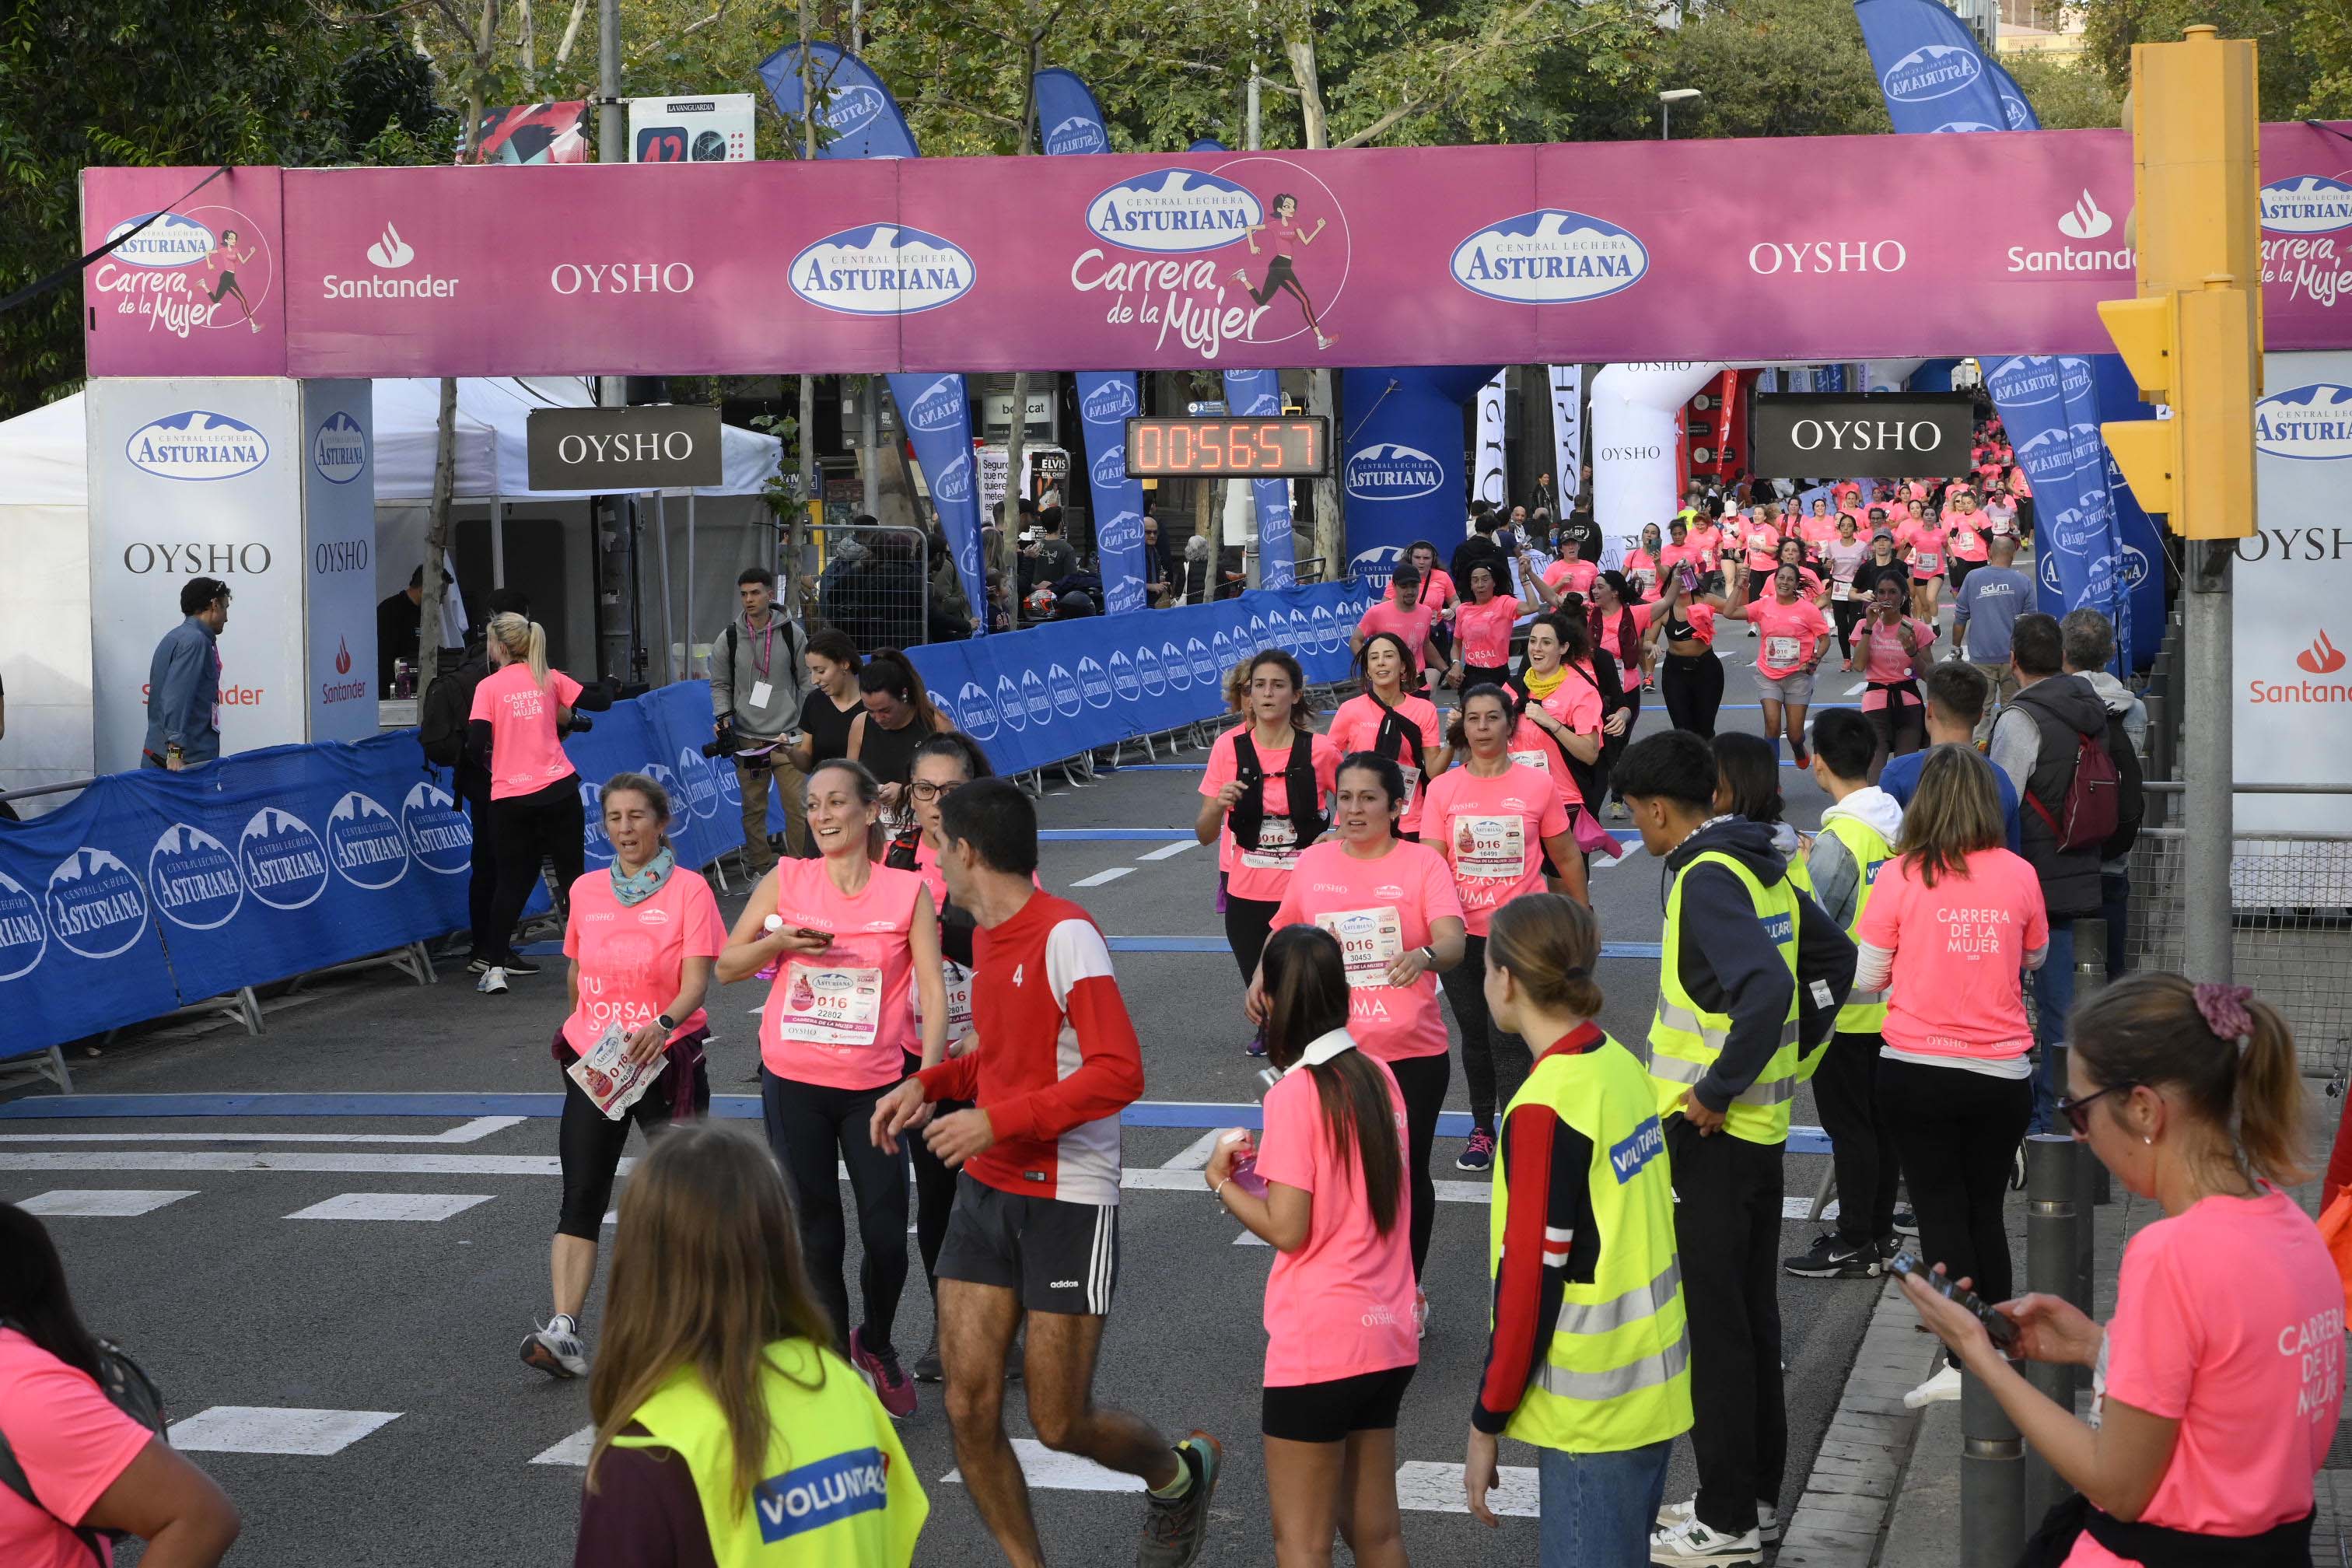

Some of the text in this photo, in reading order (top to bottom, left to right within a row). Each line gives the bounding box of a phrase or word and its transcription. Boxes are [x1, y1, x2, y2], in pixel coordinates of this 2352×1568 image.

[676, 103, 714, 111] VANGUARDIA
[1127, 196, 1244, 206] CENTRAL LECHERA
[1100, 201, 1249, 233] ASTURIANA
[1496, 241, 1626, 253] CENTRAL LECHERA
[1748, 240, 1906, 275] OYSHO
[2261, 238, 2335, 261] arrera
[831, 254, 954, 264] CENTRAL LECHERA
[1071, 248, 1216, 292] Carrera
[1466, 246, 1633, 280] ASTURIANA
[2007, 246, 2137, 272] Santand
[96, 264, 187, 292] Carrera
[551, 262, 695, 294] OYSHO
[803, 258, 961, 291] ASTURIANA
[2280, 257, 2352, 307] la Muje
[323, 275, 459, 299] Santander
[118, 292, 222, 338] de la Mujer
[1108, 285, 1271, 359] de la Mujer
[1791, 419, 1941, 452] OYSHO
[138, 437, 259, 464] ASTURIANA
[318, 440, 363, 467] ASTURIANA
[558, 432, 693, 464] OYSHO
[1139, 425, 1314, 469] 00:56:57
[1601, 446, 1661, 461] OYSHO
[1041, 459, 1066, 469] ELVIS
[984, 472, 996, 481] que
[1349, 466, 1437, 488] ASTURIANA
[124, 543, 271, 574] OYSHO
[316, 539, 368, 574] OYSHO
[1468, 649, 1496, 660] ORSAL
[323, 679, 366, 705] Santander
[1081, 677, 1111, 698] ASTURIANA
[513, 700, 526, 709] DE
[513, 706, 542, 718] MUJER
[408, 819, 473, 855] ASTURIANA
[1262, 834, 1284, 843] 016
[1477, 840, 1500, 849] 016
[255, 842, 283, 856] CENTRAL
[334, 831, 406, 870] ASTURIANA
[247, 849, 325, 889] ASTURIANA
[159, 867, 240, 908] ASTURIANA
[1313, 883, 1348, 894] OYSHO
[55, 891, 143, 937] ASTURIANA
[585, 912, 616, 922] OYSHO
[1937, 908, 2011, 924] CARRERA
[0, 914, 42, 948] RIANA
[1342, 920, 1374, 931] ASTURIANA
[1951, 923, 1997, 939] DE LA
[1346, 939, 1374, 952] 016
[1948, 940, 2000, 954] MUJER
[815, 978, 851, 987] ASTURIANA
[1012, 964, 1024, 988] 4
[817, 996, 847, 1010] 016
[948, 990, 966, 1003] 16
[1353, 999, 1388, 1016] MA
[792, 1016, 817, 1025] CARRERA
[817, 1009, 842, 1020] 22802
[789, 1027, 817, 1036] OYSHO
[1927, 1036, 1969, 1050] OYSHO
[609, 1053, 628, 1079] 016
[1050, 1280, 1079, 1289] adidas
[2302, 1346, 2322, 1384] DE
